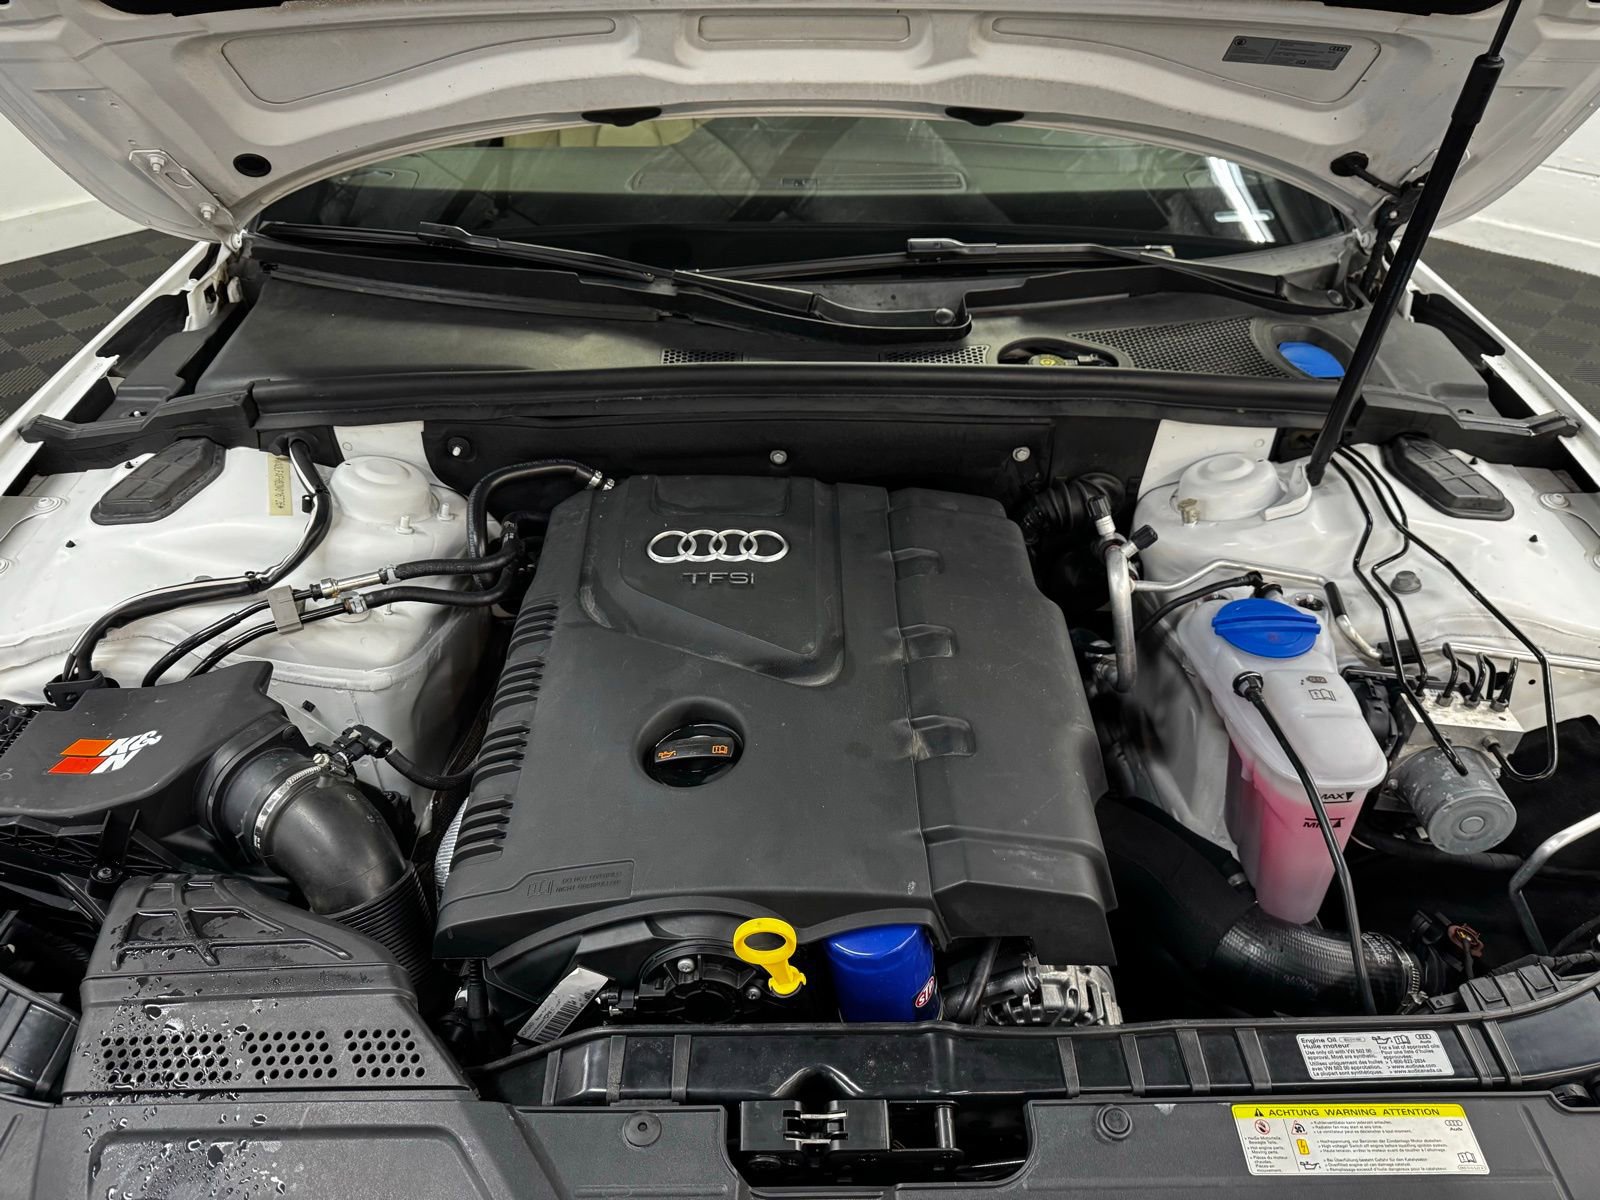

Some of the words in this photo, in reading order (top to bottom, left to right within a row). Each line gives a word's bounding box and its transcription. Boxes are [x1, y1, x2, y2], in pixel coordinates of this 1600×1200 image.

[1269, 1108, 1319, 1116] ACHTUNG
[1324, 1108, 1377, 1116] WARNING
[1383, 1108, 1440, 1116] ATTENTION
